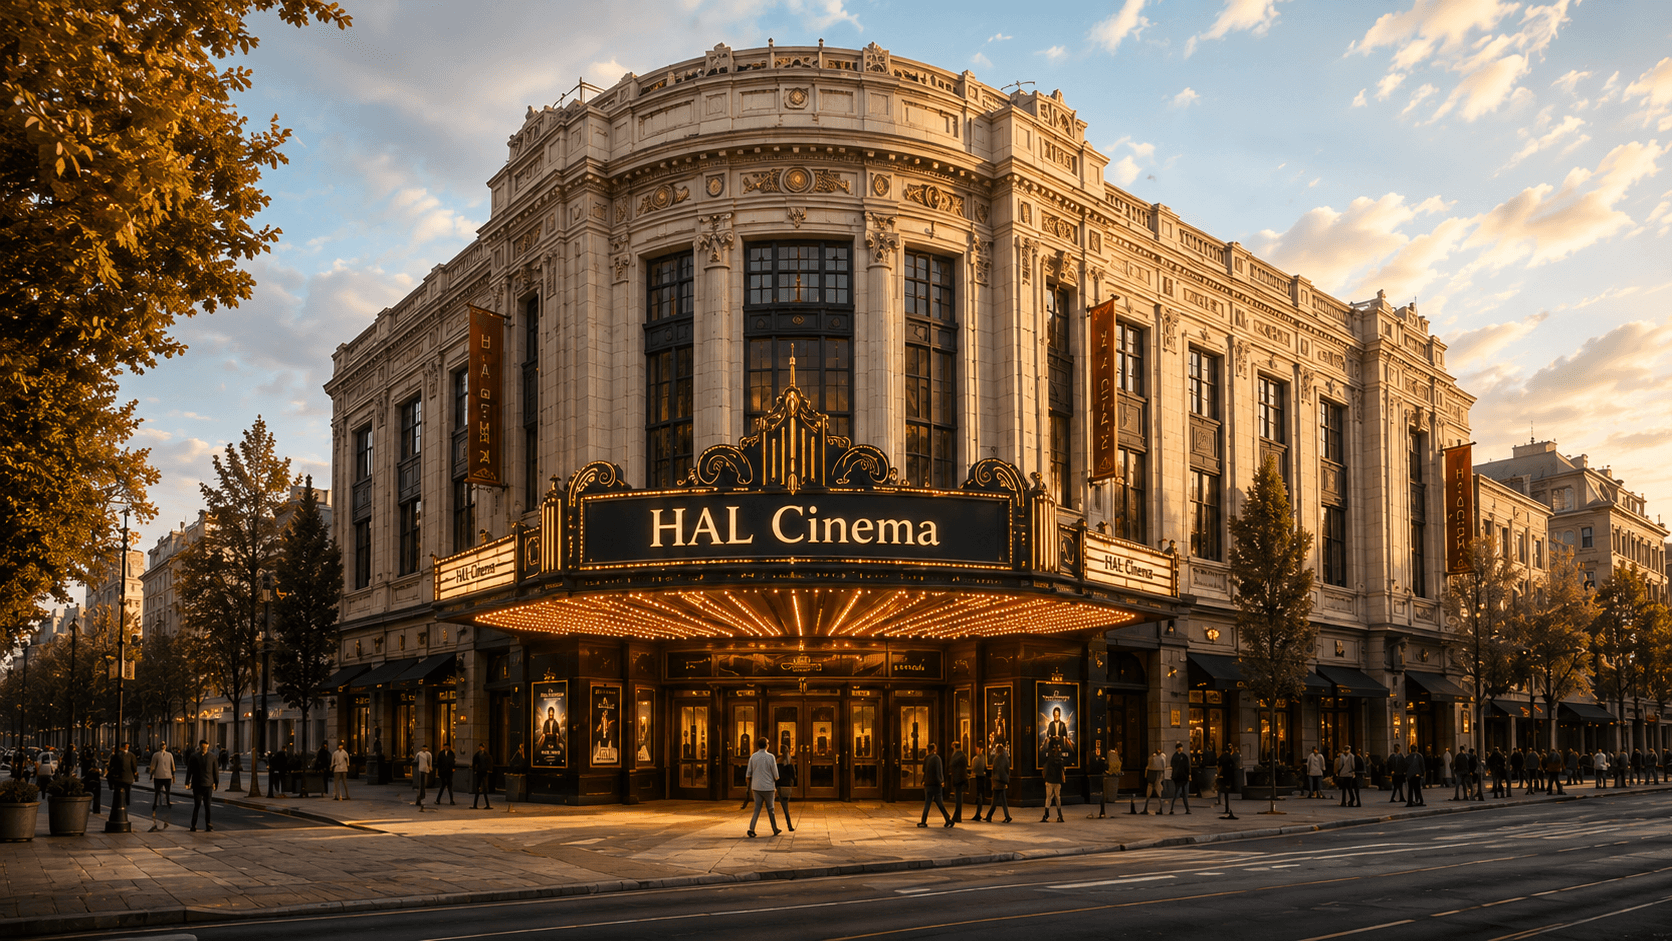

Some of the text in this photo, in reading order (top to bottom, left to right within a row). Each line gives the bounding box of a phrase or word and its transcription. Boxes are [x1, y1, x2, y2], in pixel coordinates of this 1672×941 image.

[650, 505, 941, 548] HAL Cinema
[1105, 555, 1153, 579] HAL Cinema
